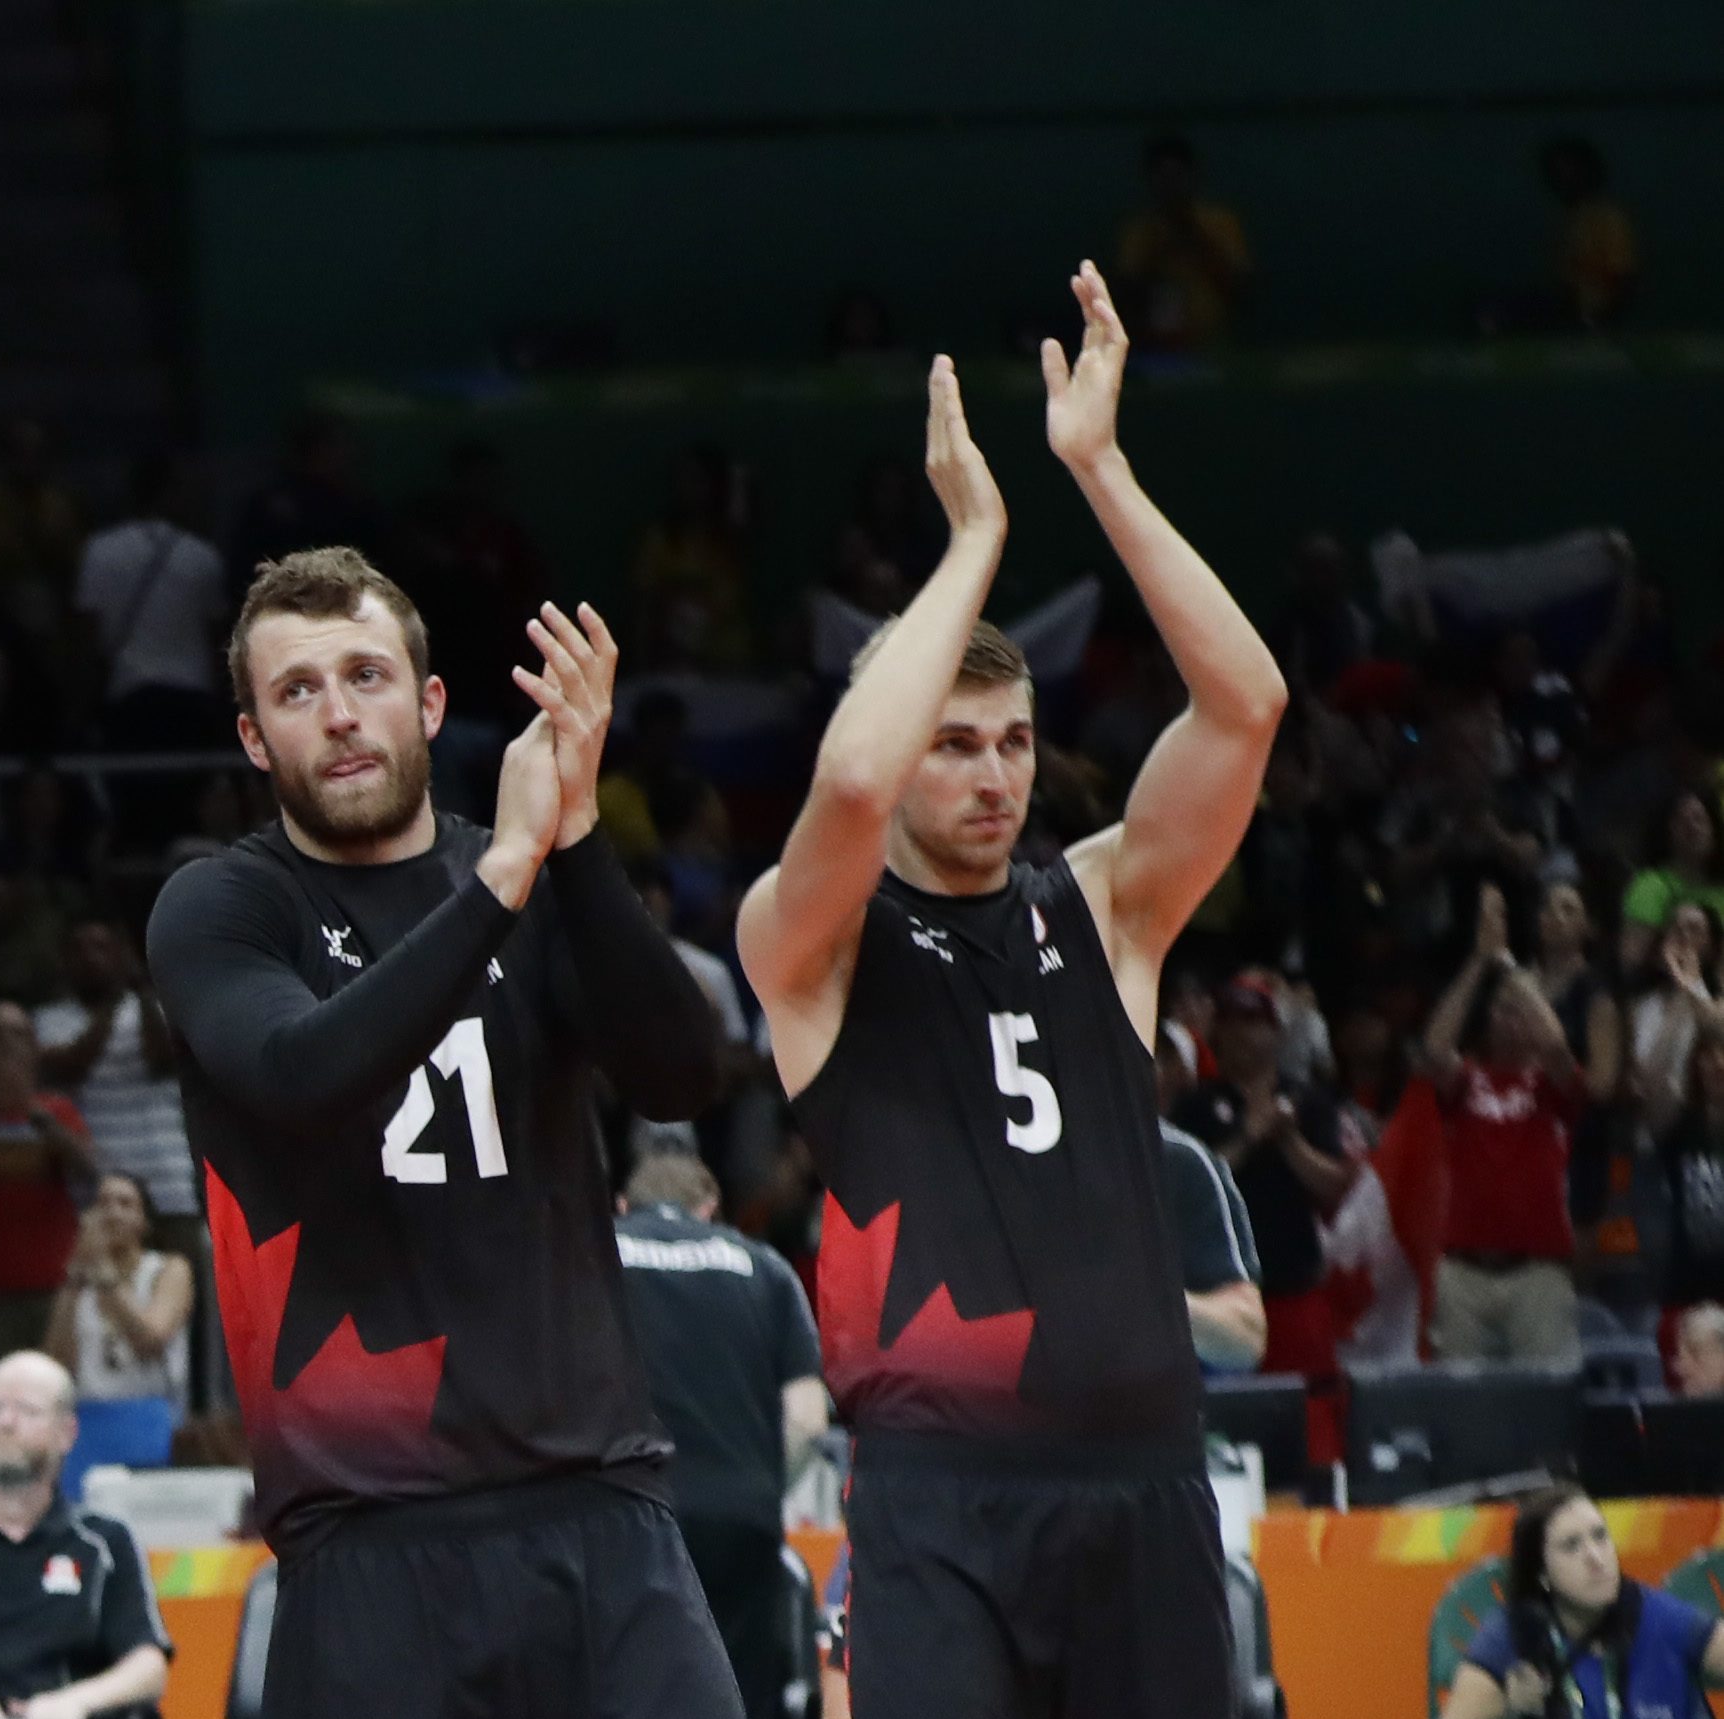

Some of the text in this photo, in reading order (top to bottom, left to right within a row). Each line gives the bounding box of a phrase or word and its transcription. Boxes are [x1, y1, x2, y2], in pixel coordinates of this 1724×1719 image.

[1038, 944, 1065, 976] AN
[381, 1017, 509, 1184] 21
[988, 1011, 1063, 1154] 5
